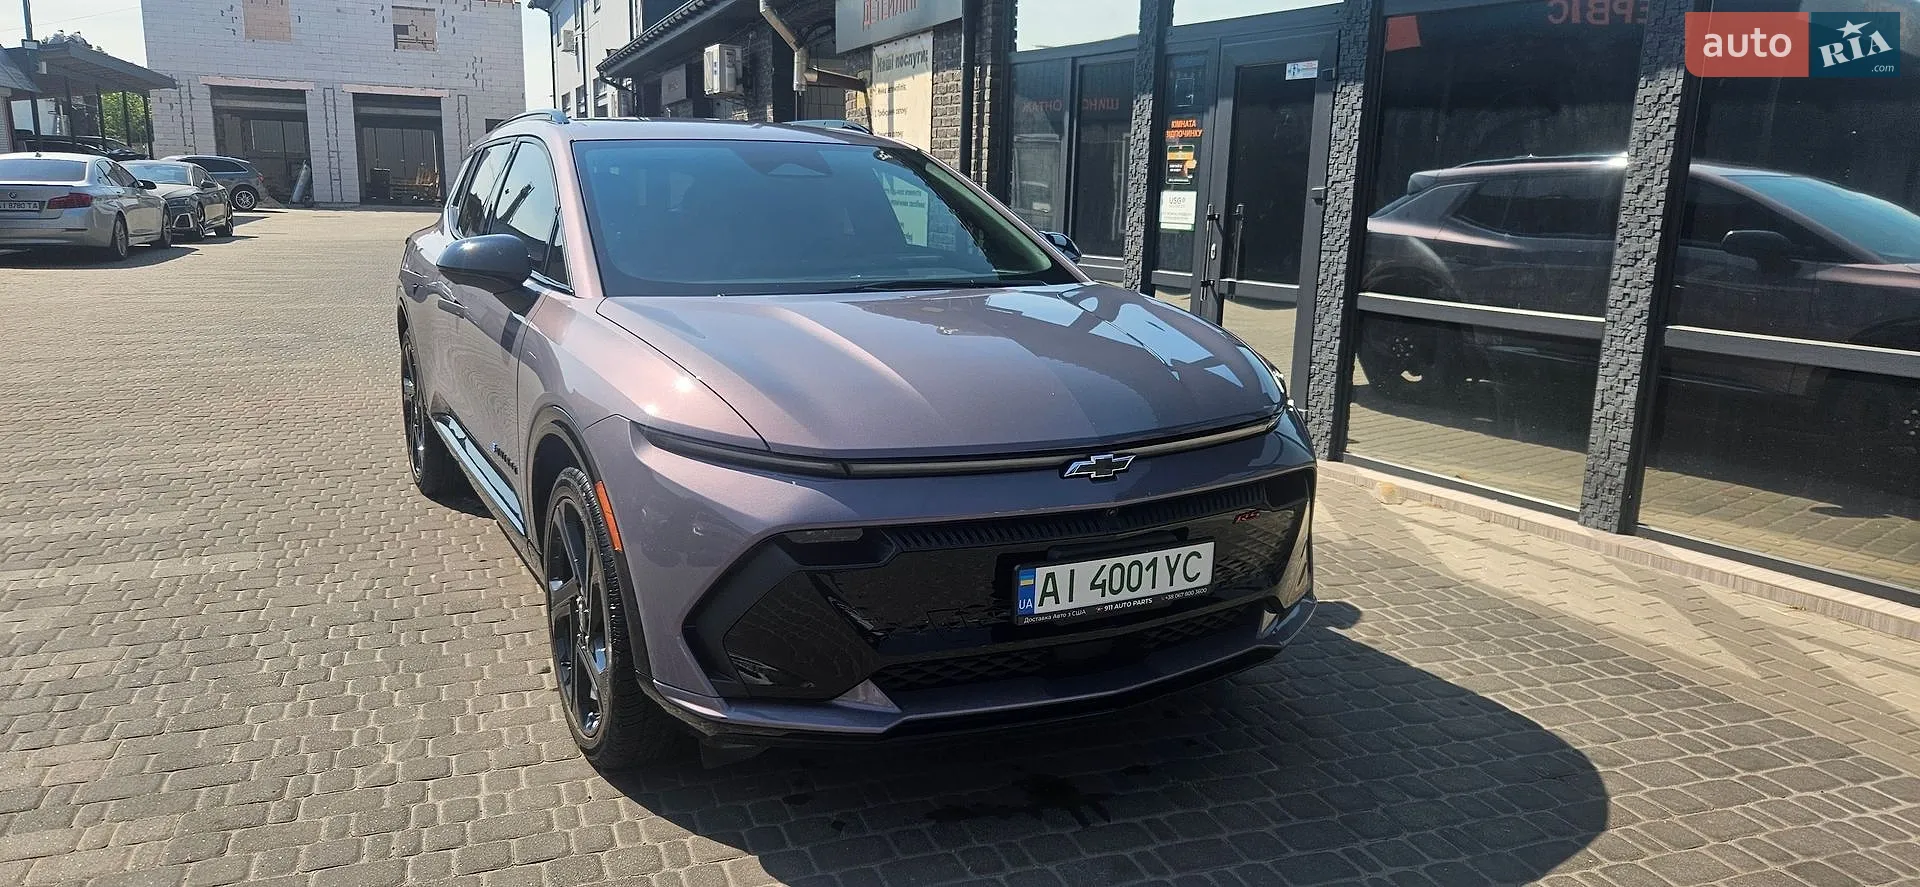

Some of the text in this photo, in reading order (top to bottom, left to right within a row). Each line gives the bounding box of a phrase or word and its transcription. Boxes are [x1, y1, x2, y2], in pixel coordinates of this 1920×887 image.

[1038, 569, 1075, 607] AI
[1019, 599, 1033, 610] UA
[1104, 598, 1153, 611] 911 AUTO PARTS
[1024, 615, 1051, 623] Доставка
[1053, 611, 1067, 619] Авто
[1072, 608, 1087, 616] США
